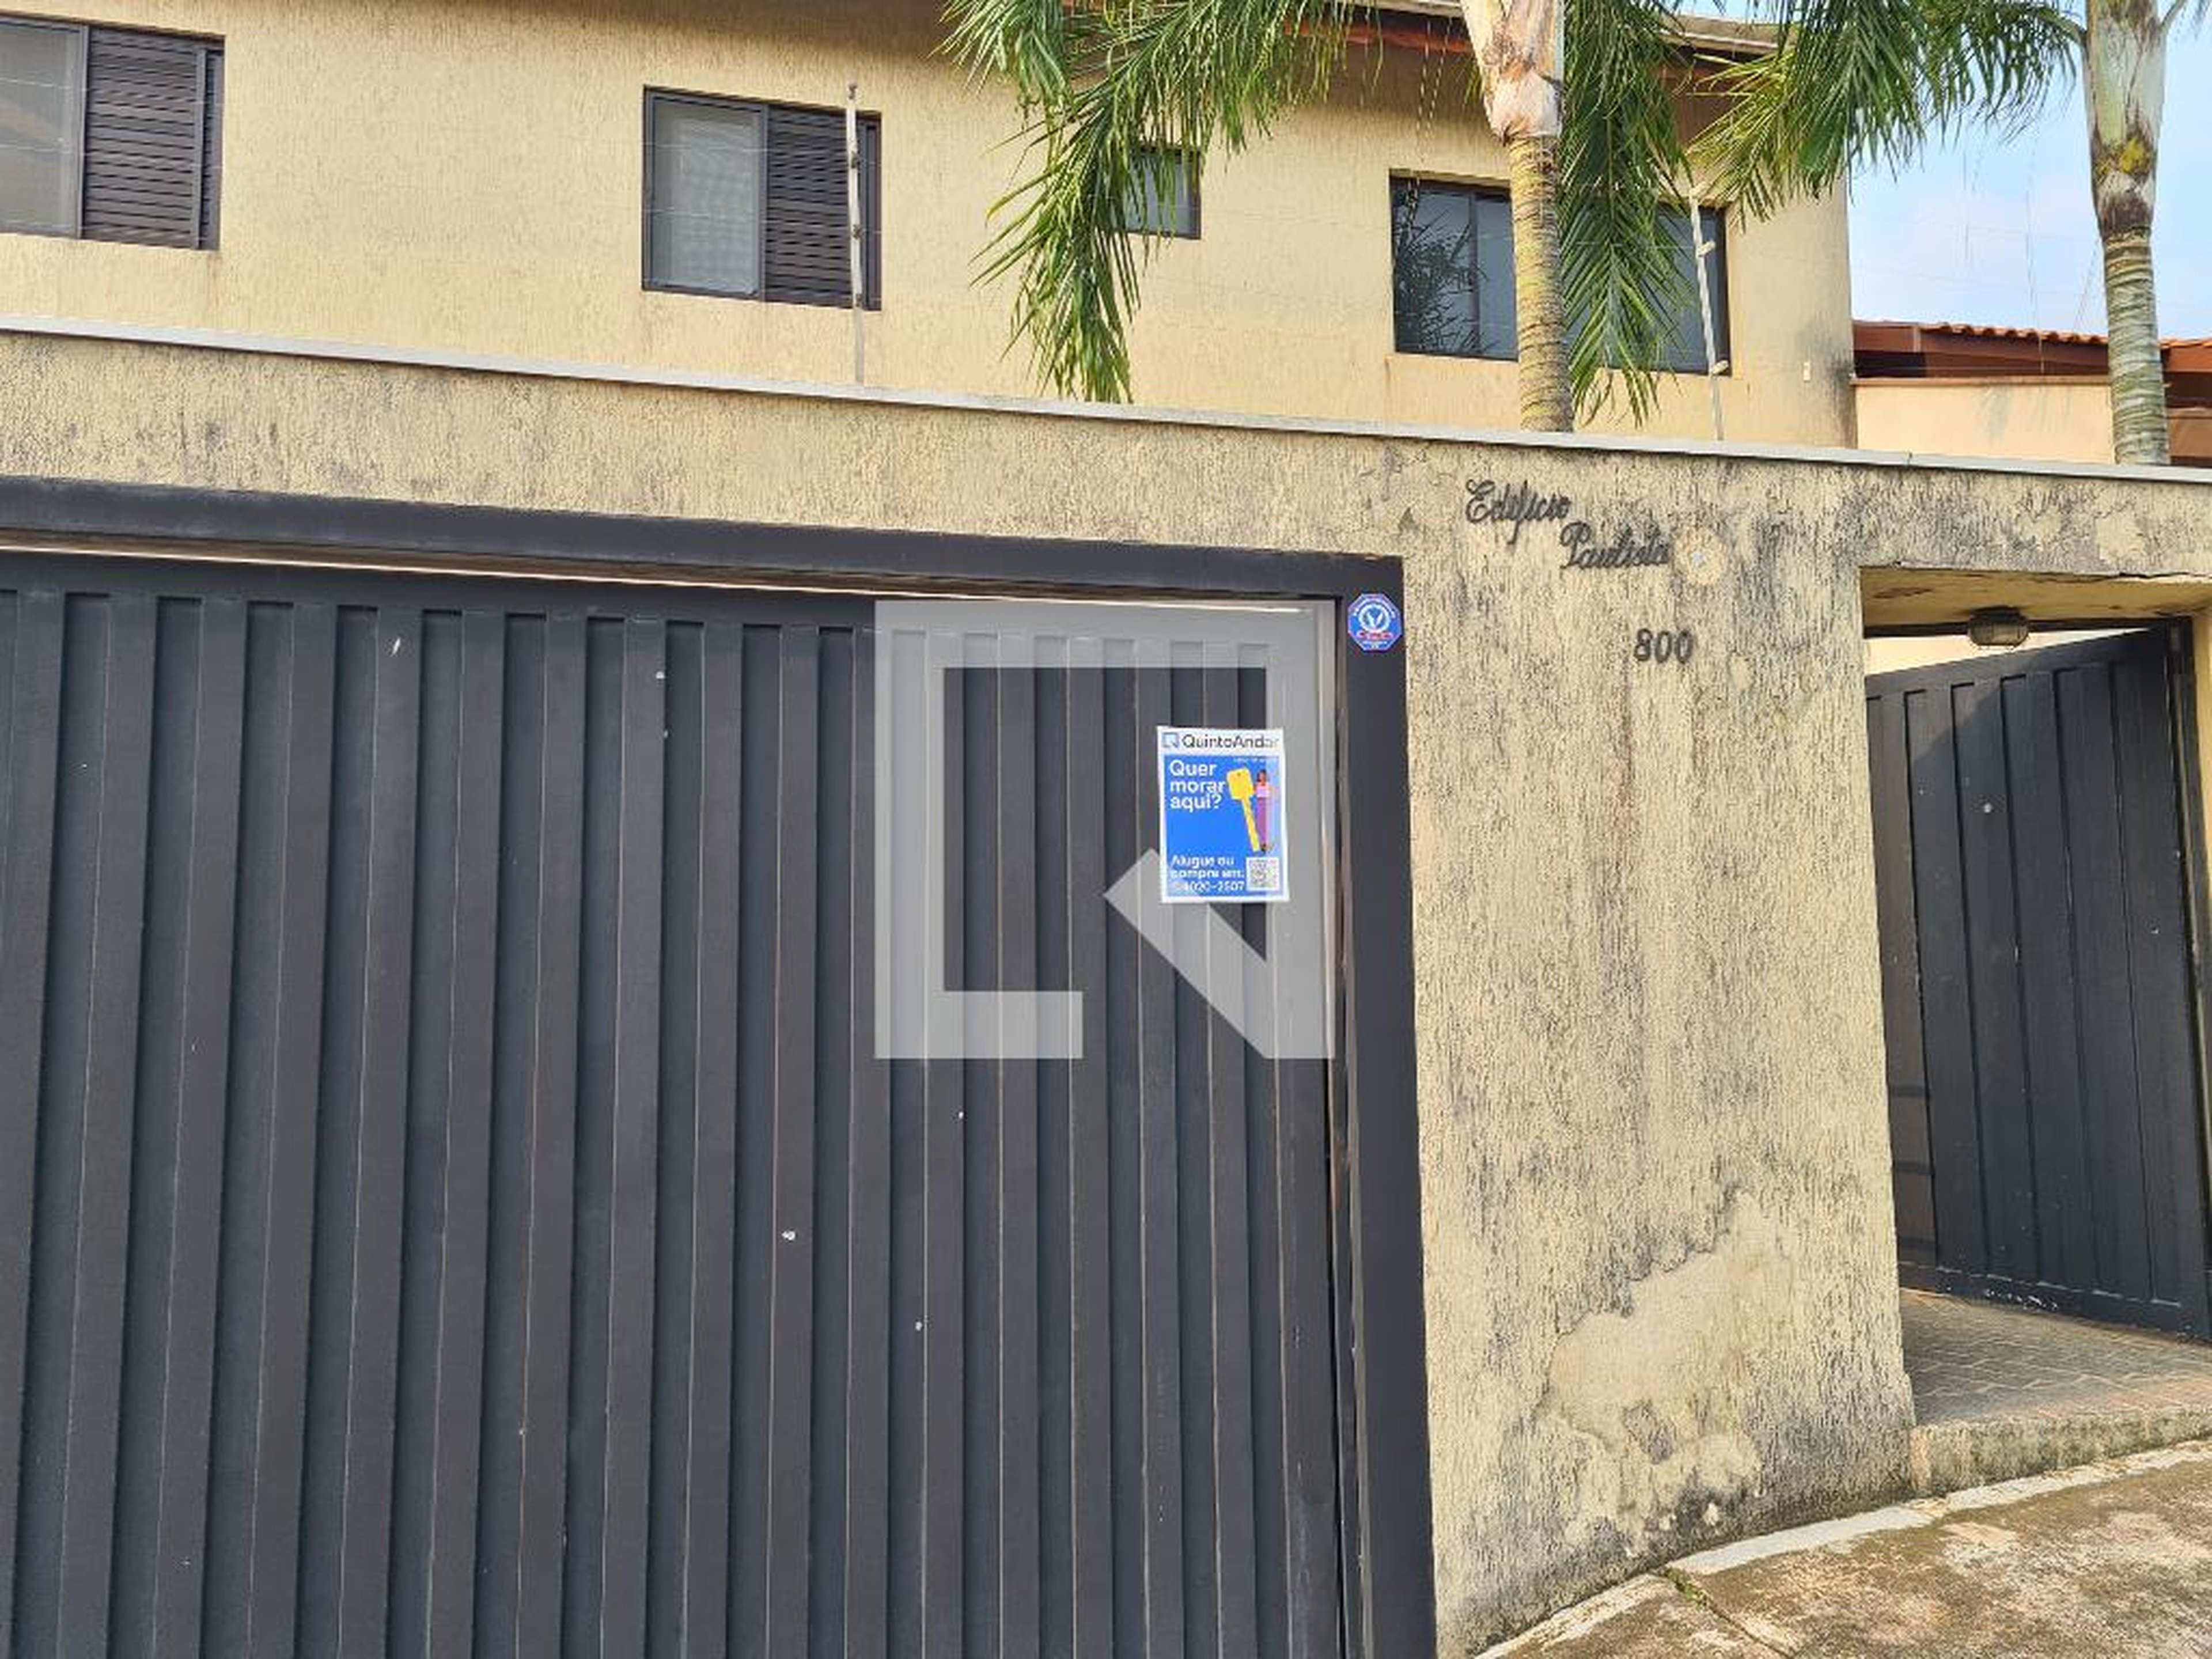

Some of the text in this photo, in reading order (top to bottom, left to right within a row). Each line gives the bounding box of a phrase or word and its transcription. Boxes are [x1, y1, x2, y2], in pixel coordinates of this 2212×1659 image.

[1634, 628, 1694, 663] 800
[1182, 733, 1279, 748] QuintoAndar
[1170, 760, 1217, 777] Quer
[1170, 781, 1225, 794] morar
[1170, 794, 1222, 812] aqui?
[1171, 855, 1234, 869] Alugue ou
